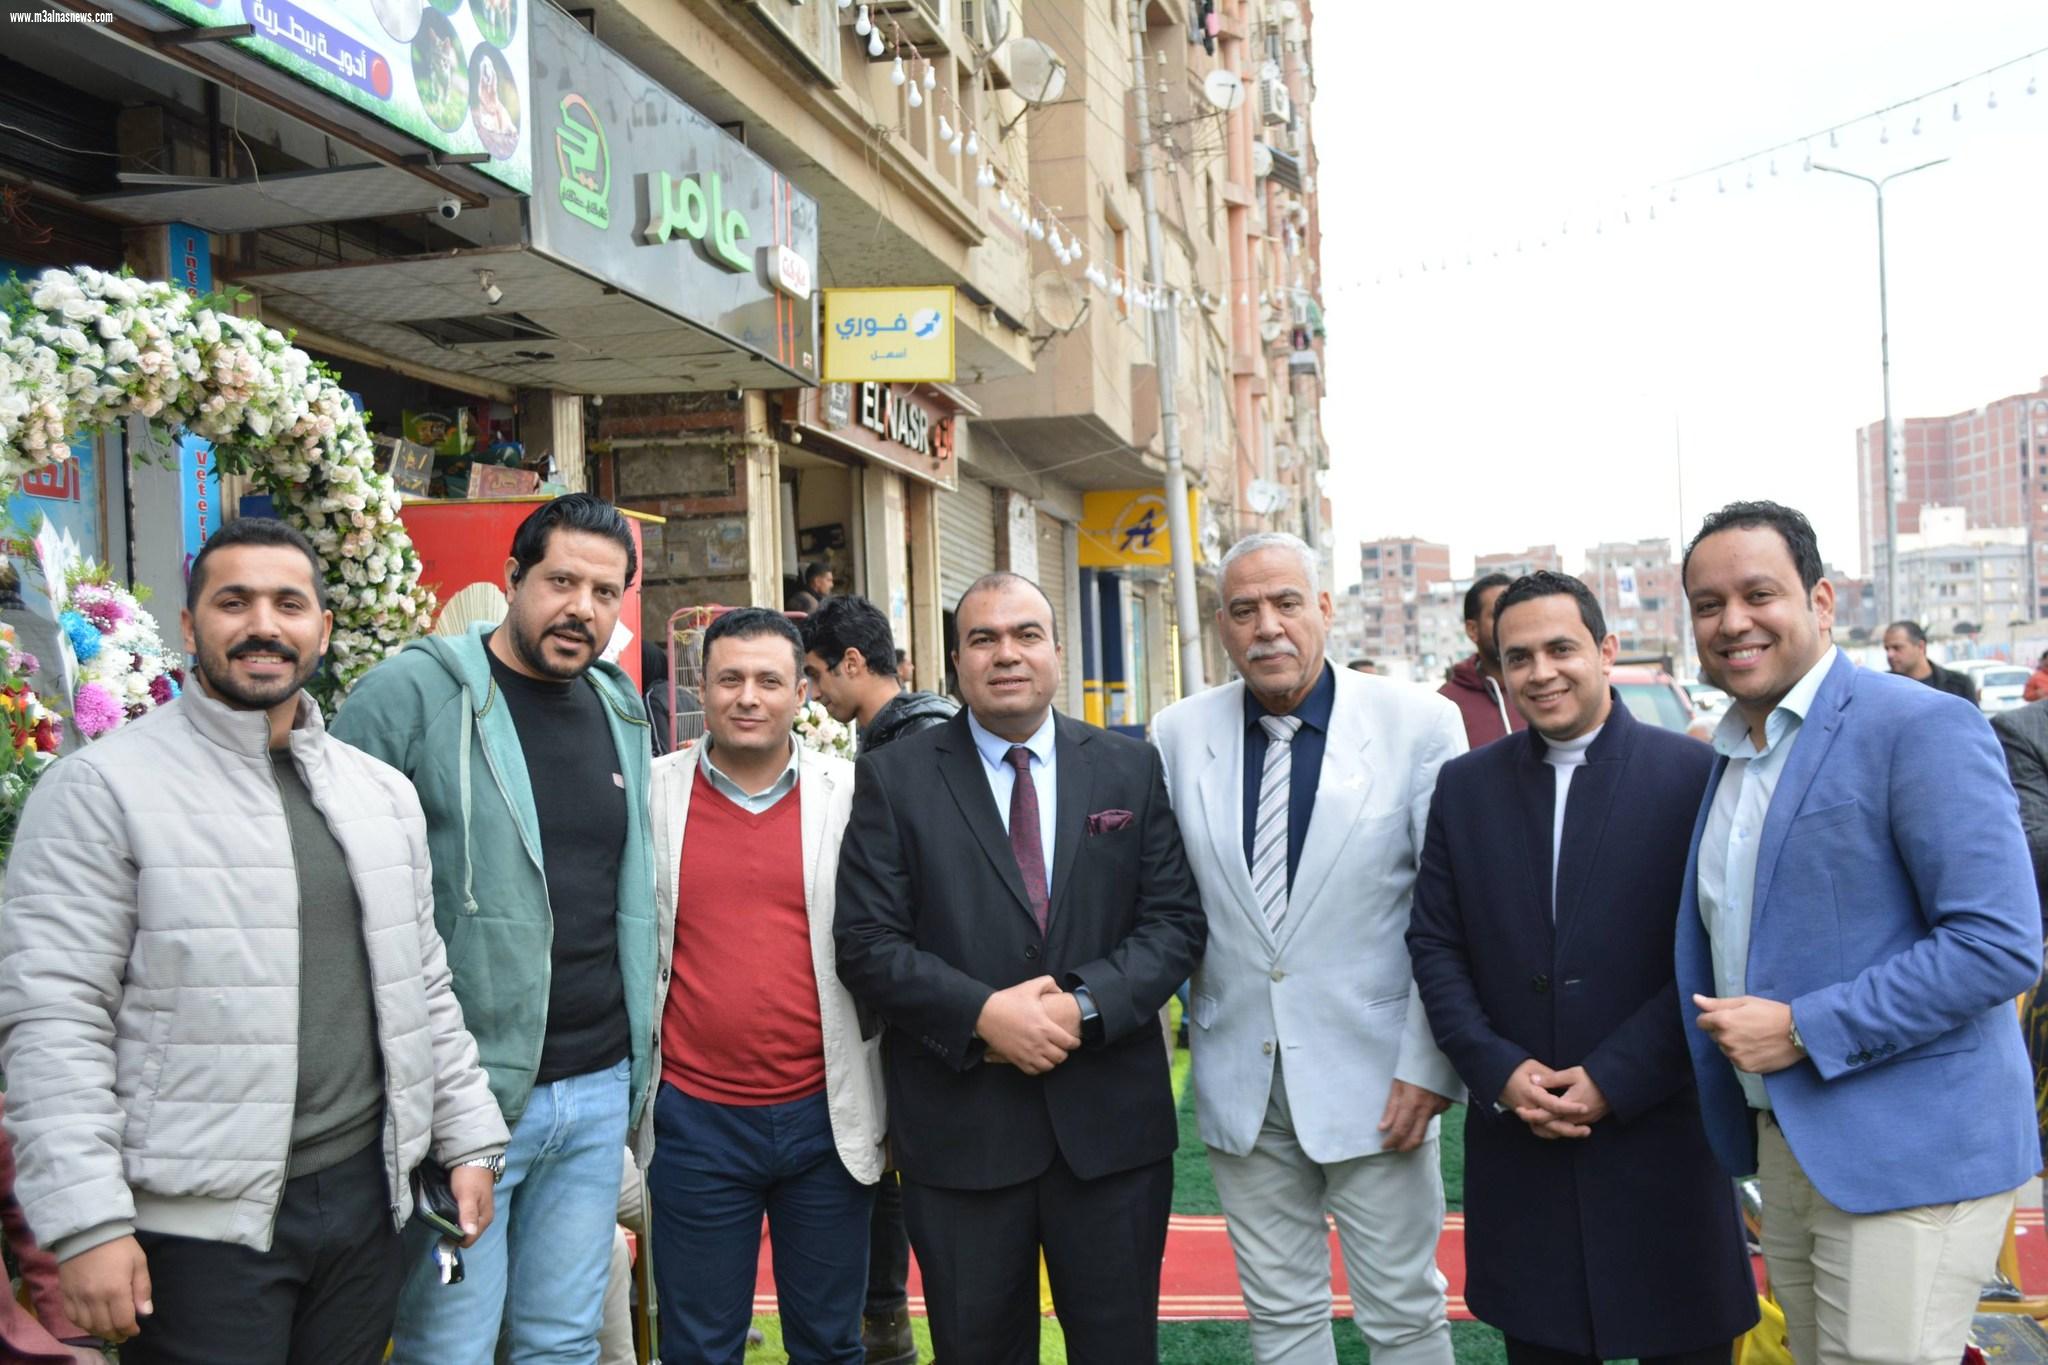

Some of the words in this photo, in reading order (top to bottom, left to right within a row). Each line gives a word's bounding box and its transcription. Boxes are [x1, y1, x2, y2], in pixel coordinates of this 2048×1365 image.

[253, 0, 317, 57] بيطرية
[317, 32, 367, 80] أدوية
[652, 170, 753, 273] عامر
[835, 313, 908, 340] فوري
